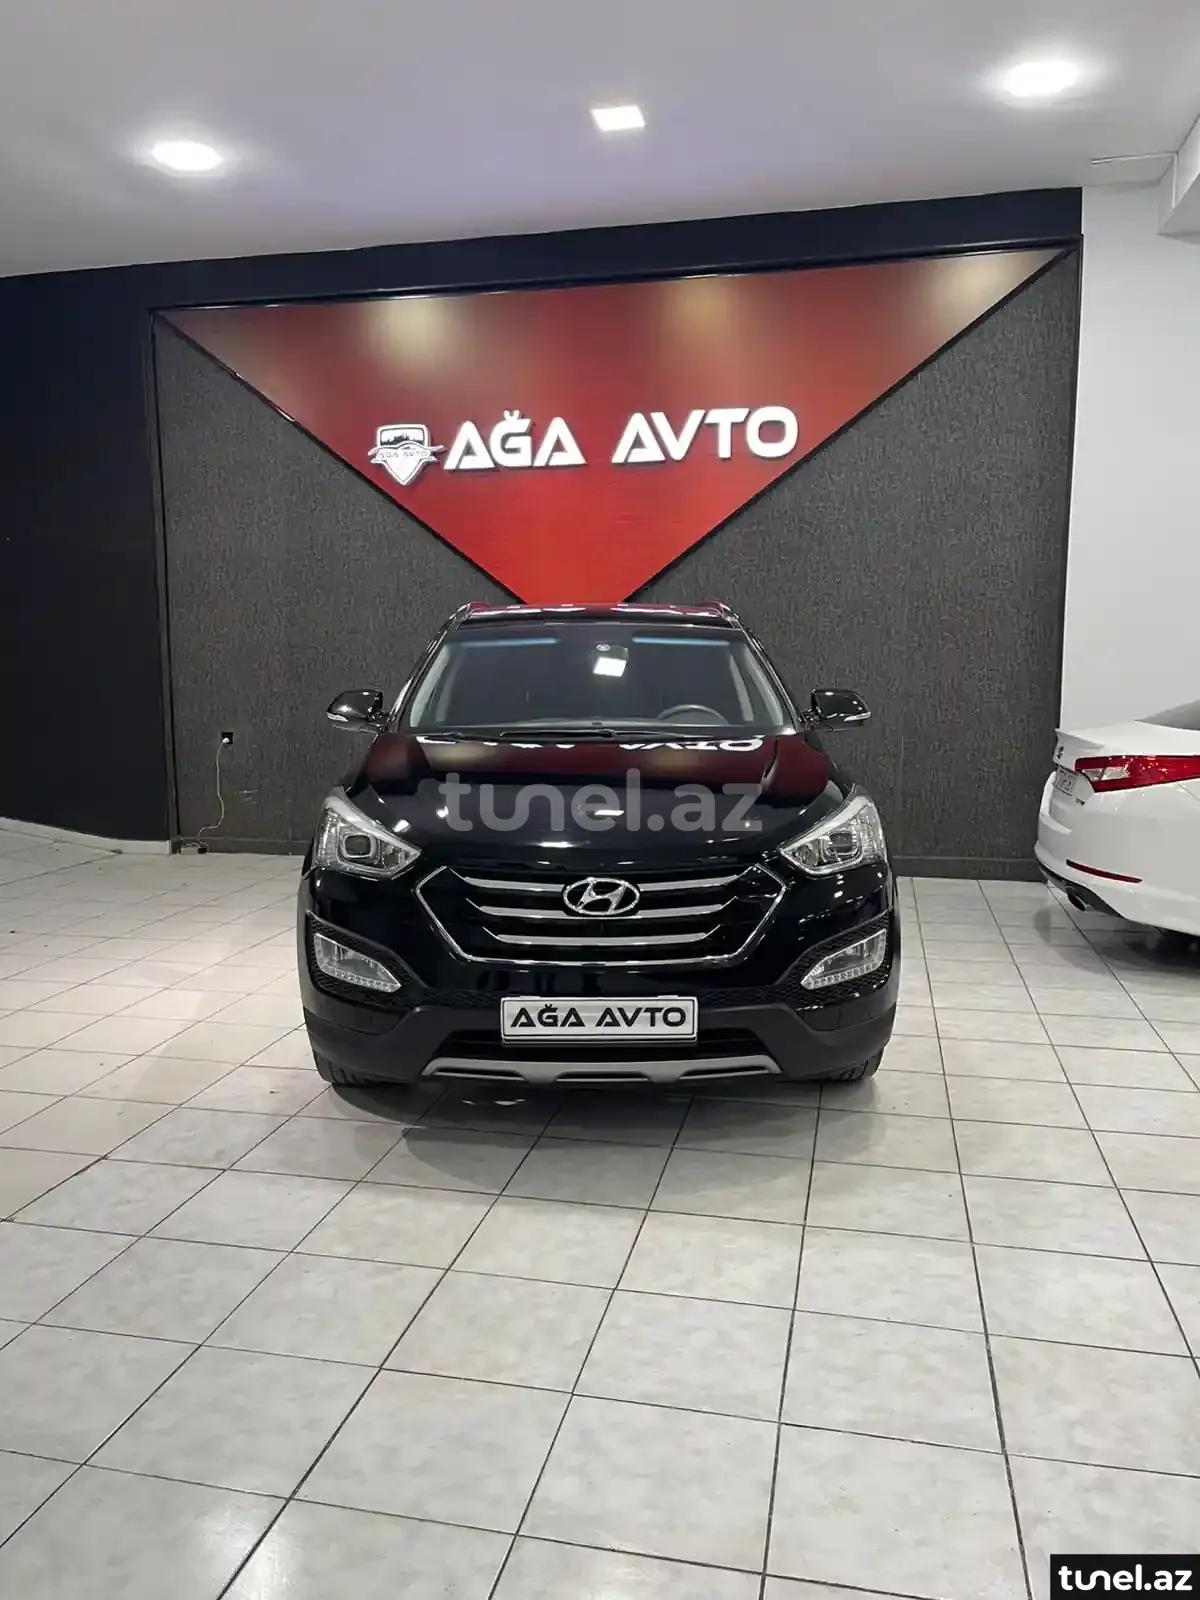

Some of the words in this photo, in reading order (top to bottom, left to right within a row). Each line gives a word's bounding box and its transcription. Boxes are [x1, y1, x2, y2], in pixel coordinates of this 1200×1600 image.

[444, 410, 587, 469] AĞA
[611, 406, 798, 463] AVTO
[510, 1004, 585, 1027] AĞA
[595, 1007, 687, 1027] AVTO
